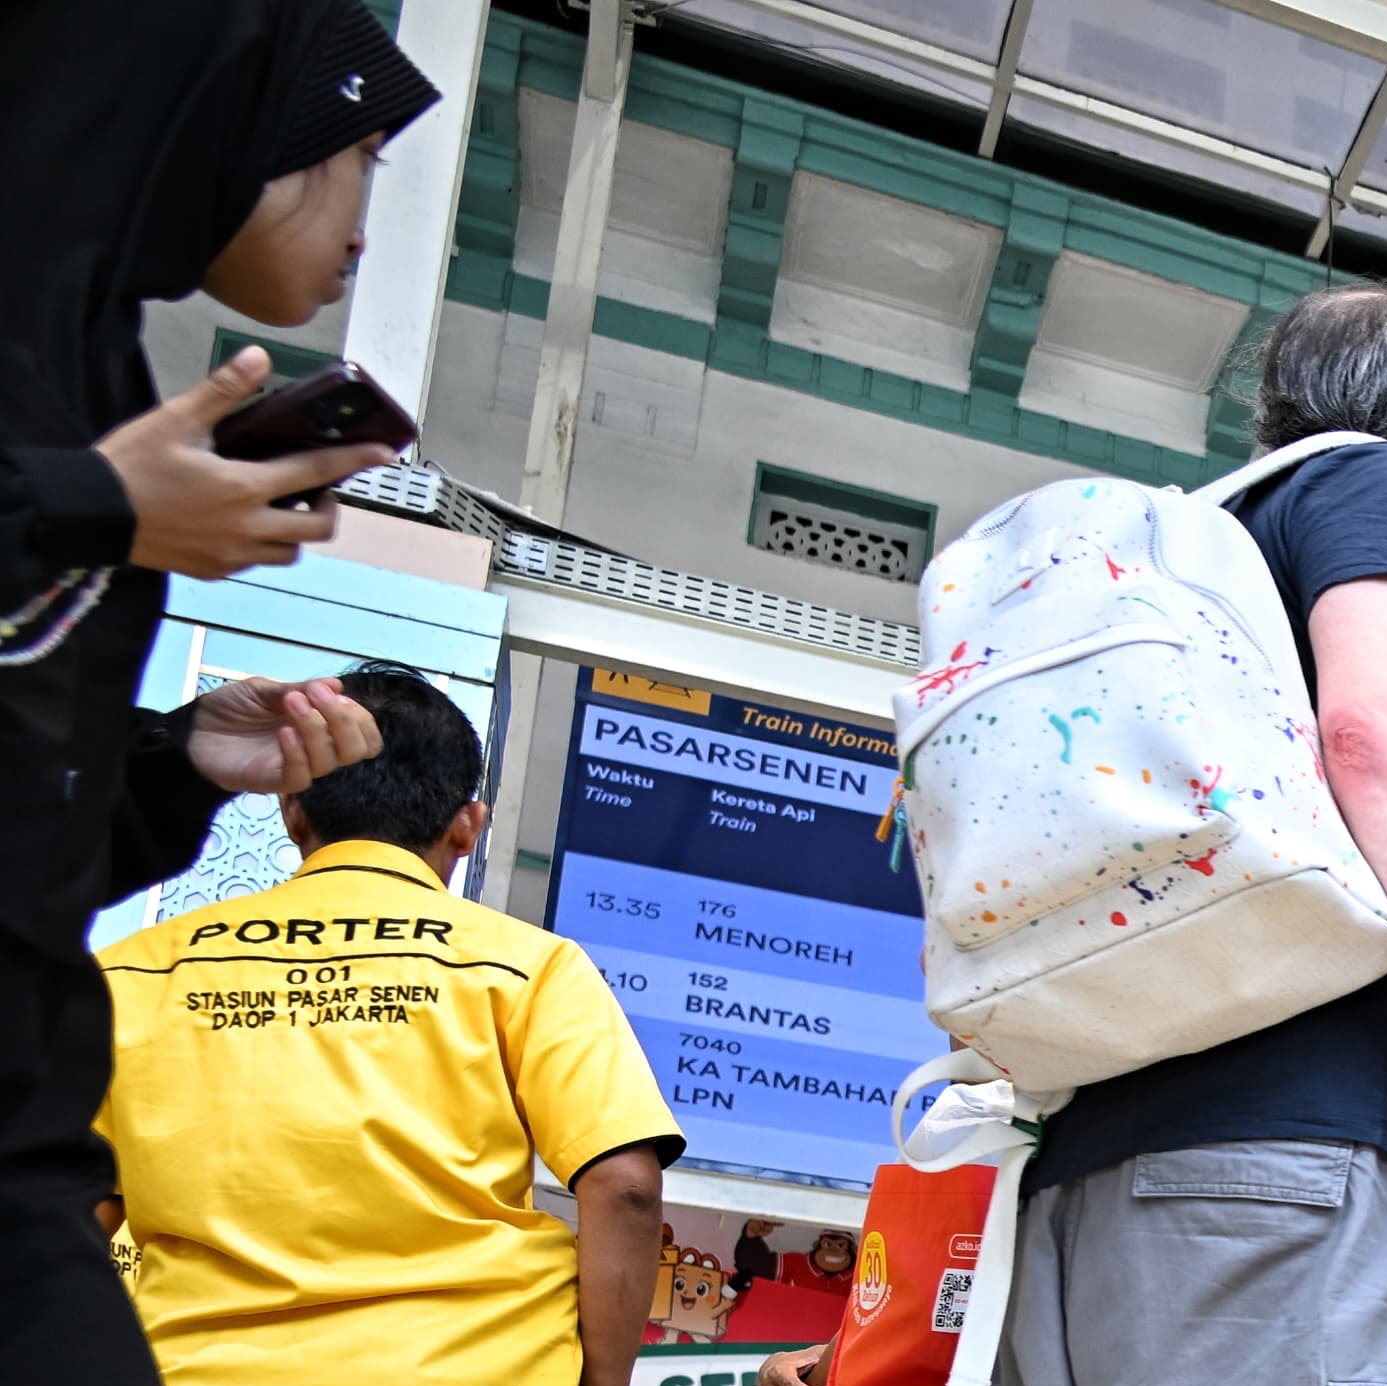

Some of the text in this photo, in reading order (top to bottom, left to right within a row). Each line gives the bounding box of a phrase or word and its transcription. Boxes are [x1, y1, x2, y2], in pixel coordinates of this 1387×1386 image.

[742, 707, 804, 736] Train
[594, 718, 868, 796] PASARSENEN
[587, 762, 654, 789] Waktu
[585, 785, 633, 808] Time
[711, 789, 816, 823] Kereta Api
[709, 810, 757, 833] Train
[585, 891, 661, 919] 13.35
[698, 899, 737, 918] 176
[189, 918, 453, 946] PORTER
[695, 922, 854, 967] MENOREH
[286, 966, 351, 985] 001
[689, 971, 728, 991] 152
[186, 985, 439, 1011] STASIUN PASAR SENEN
[212, 1005, 409, 1030] DAOP 1 JAKARTA
[685, 994, 832, 1035] BRANTAS
[679, 1033, 742, 1055] 7040
[677, 1056, 721, 1080] KA
[673, 1085, 734, 1110] LPN
[865, 1251, 882, 1289] 30
